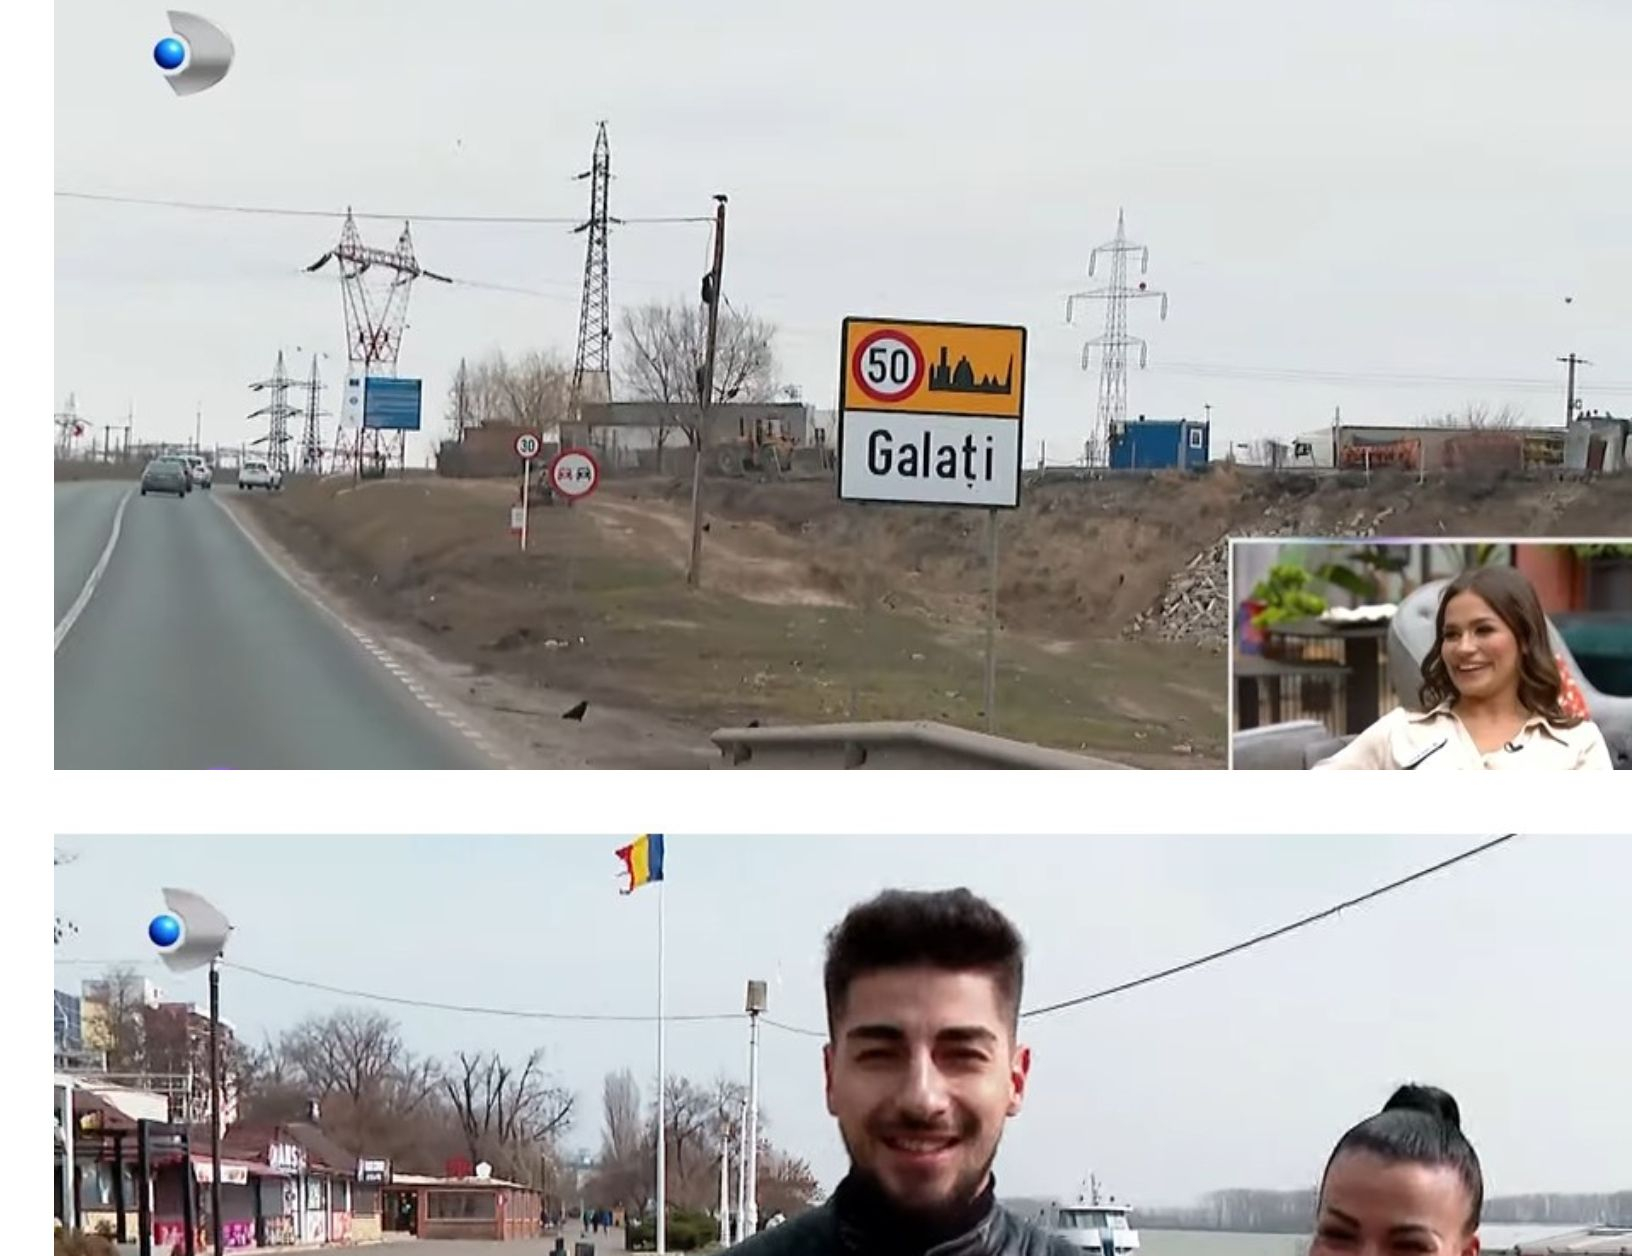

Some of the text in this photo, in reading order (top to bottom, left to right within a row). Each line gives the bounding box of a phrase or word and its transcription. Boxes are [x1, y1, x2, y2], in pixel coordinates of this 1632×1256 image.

[867, 347, 910, 384] 50
[520, 438, 535, 453] 30
[867, 429, 994, 489] Galați
